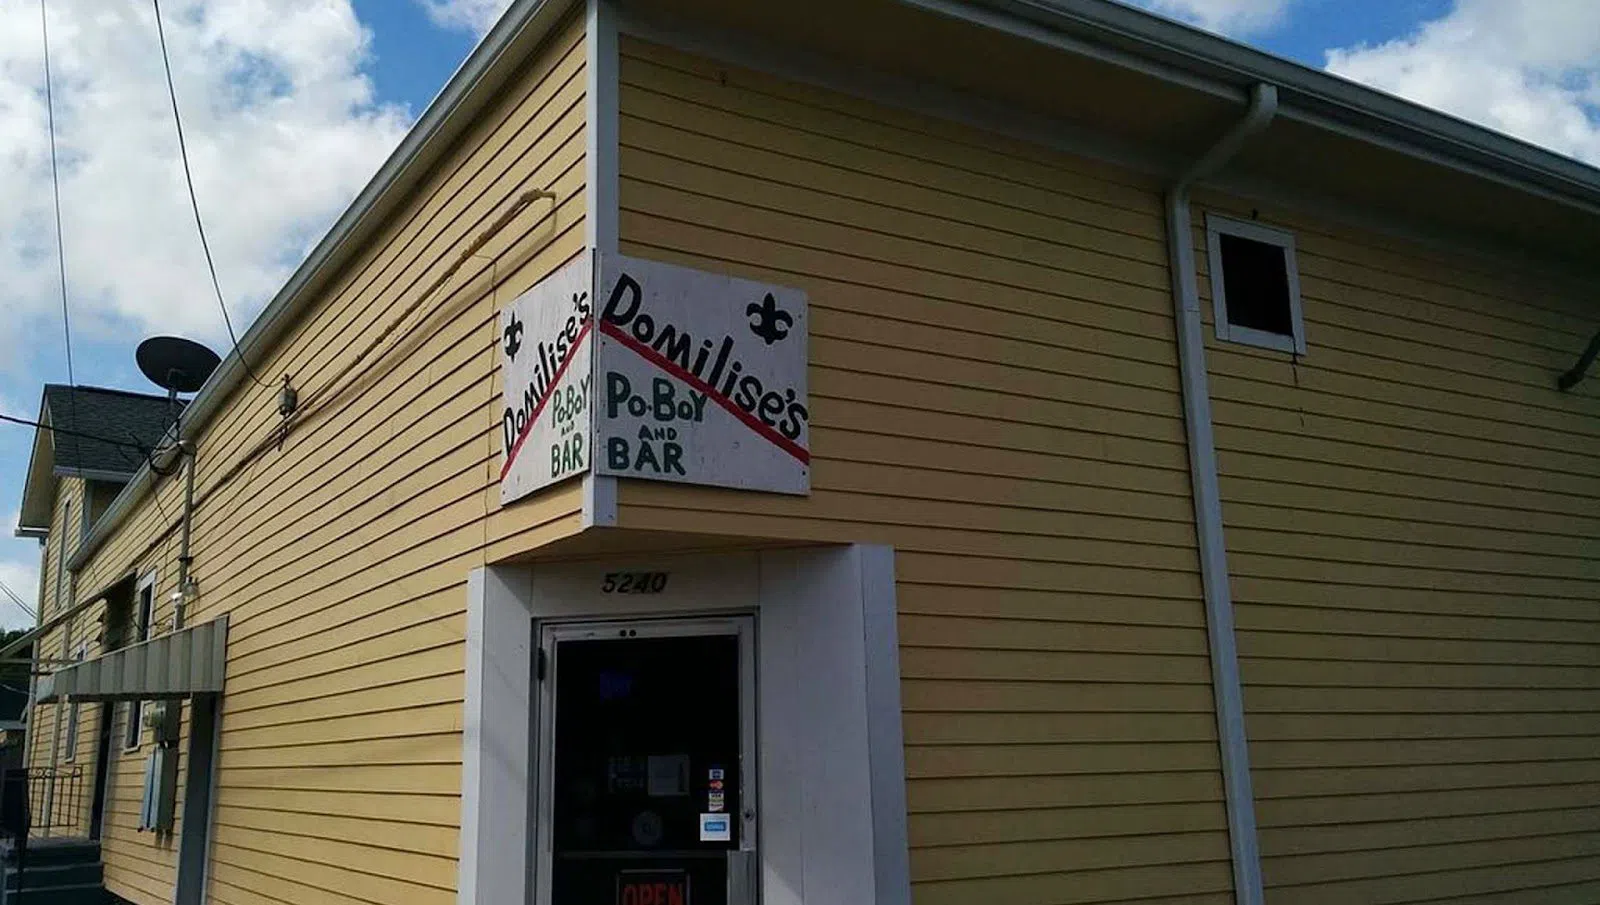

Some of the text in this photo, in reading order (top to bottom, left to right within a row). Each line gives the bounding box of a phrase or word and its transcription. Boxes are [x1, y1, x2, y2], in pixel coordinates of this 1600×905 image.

[638, 424, 678, 441] AND
[551, 432, 584, 478] BAR
[608, 436, 687, 476] BAR
[602, 571, 668, 594] 5240
[623, 883, 683, 905] OPEN
